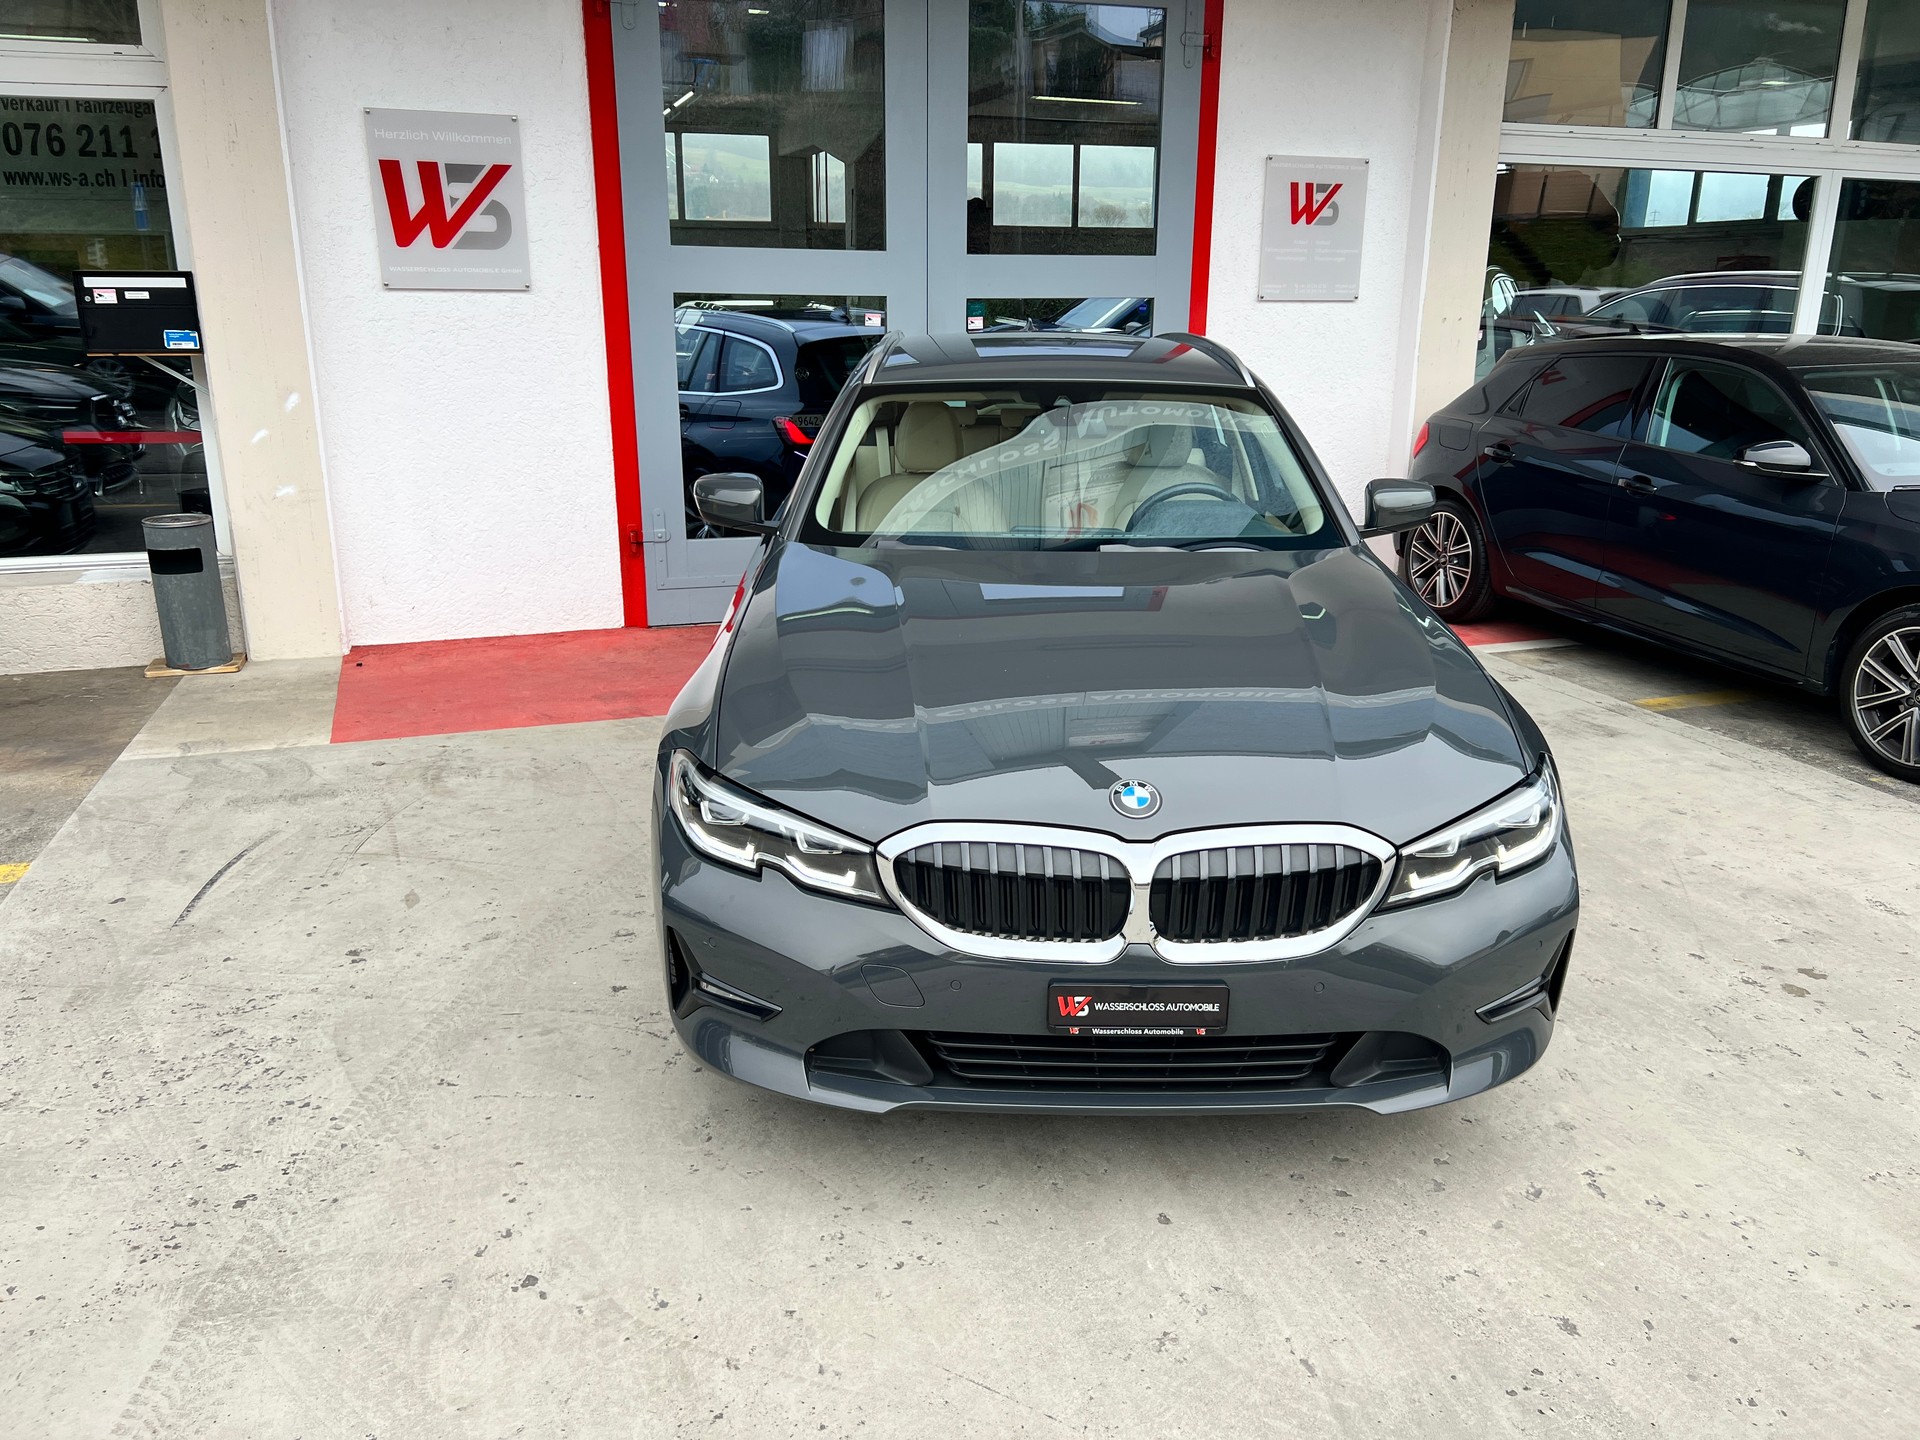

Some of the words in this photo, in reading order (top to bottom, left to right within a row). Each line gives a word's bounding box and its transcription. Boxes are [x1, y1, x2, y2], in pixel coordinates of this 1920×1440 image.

[2, 121, 66, 157] 076
[76, 123, 138, 159] 211
[374, 128, 429, 141] Herzlich
[431, 130, 512, 145] Willkommen
[3, 168, 115, 188] www.ws-a.ch
[1116, 780, 1154, 793] BMW
[1094, 1002, 1165, 1012] WASSERSCHLOSS
[1166, 1002, 1220, 1012] AUTOMOBILE
